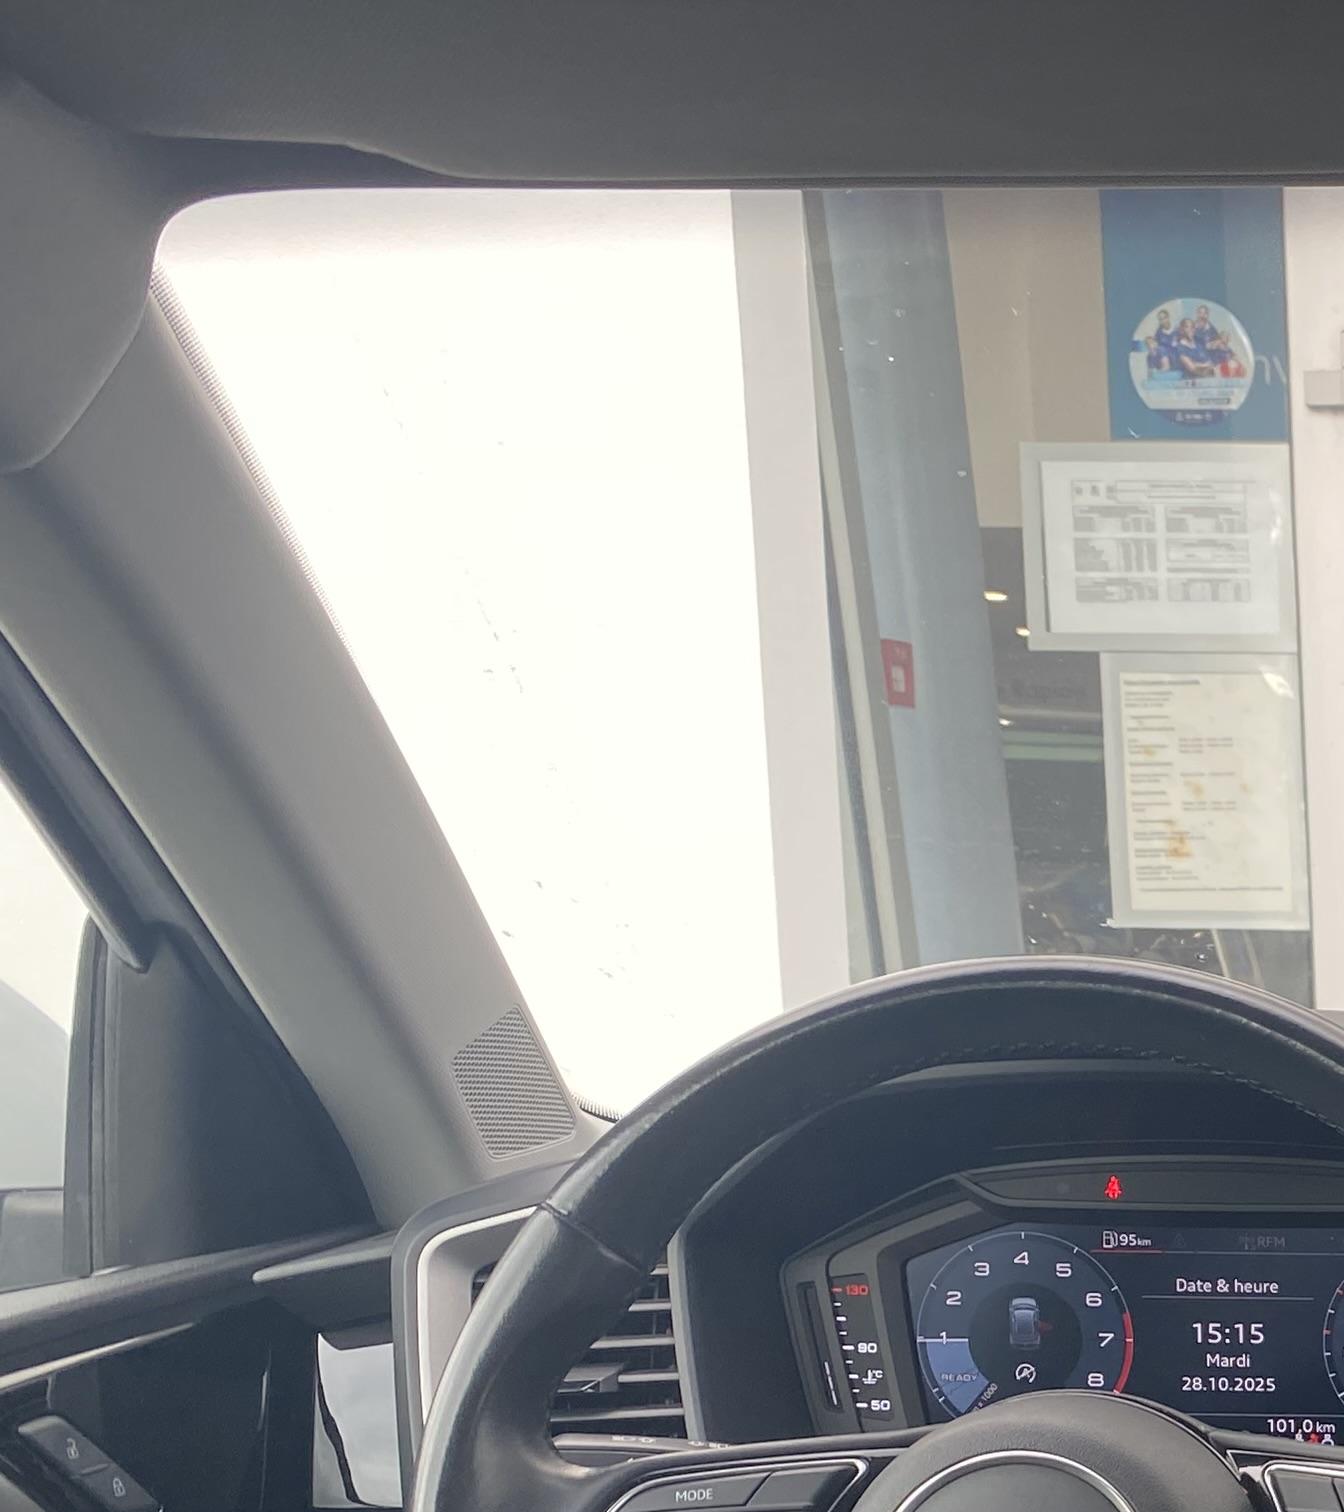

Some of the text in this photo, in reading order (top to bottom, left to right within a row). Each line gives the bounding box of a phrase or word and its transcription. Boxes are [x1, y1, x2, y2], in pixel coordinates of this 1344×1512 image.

[1013, 1252, 1029, 1265] 4
[974, 1263, 990, 1276] 3
[1055, 1263, 1072, 1277] 5
[845, 1285, 869, 1296] 130
[1176, 1279, 1279, 1294] Date & heure
[946, 1291, 962, 1305] 2
[1085, 1292, 1102, 1307] 6
[1098, 1333, 1115, 1347] 7
[1192, 1323, 1264, 1345] 15:15
[857, 1342, 877, 1353] 90
[1206, 1353, 1250, 1367] Mardi
[940, 1373, 977, 1383] READY
[1088, 1373, 1104, 1387] 8
[1181, 1376, 1276, 1392] 28.10.2025
[981, 1383, 998, 1401] 1000
[870, 1400, 890, 1411] 50
[1316, 1422, 1336, 1433] km
[675, 1488, 713, 1502] MODE
